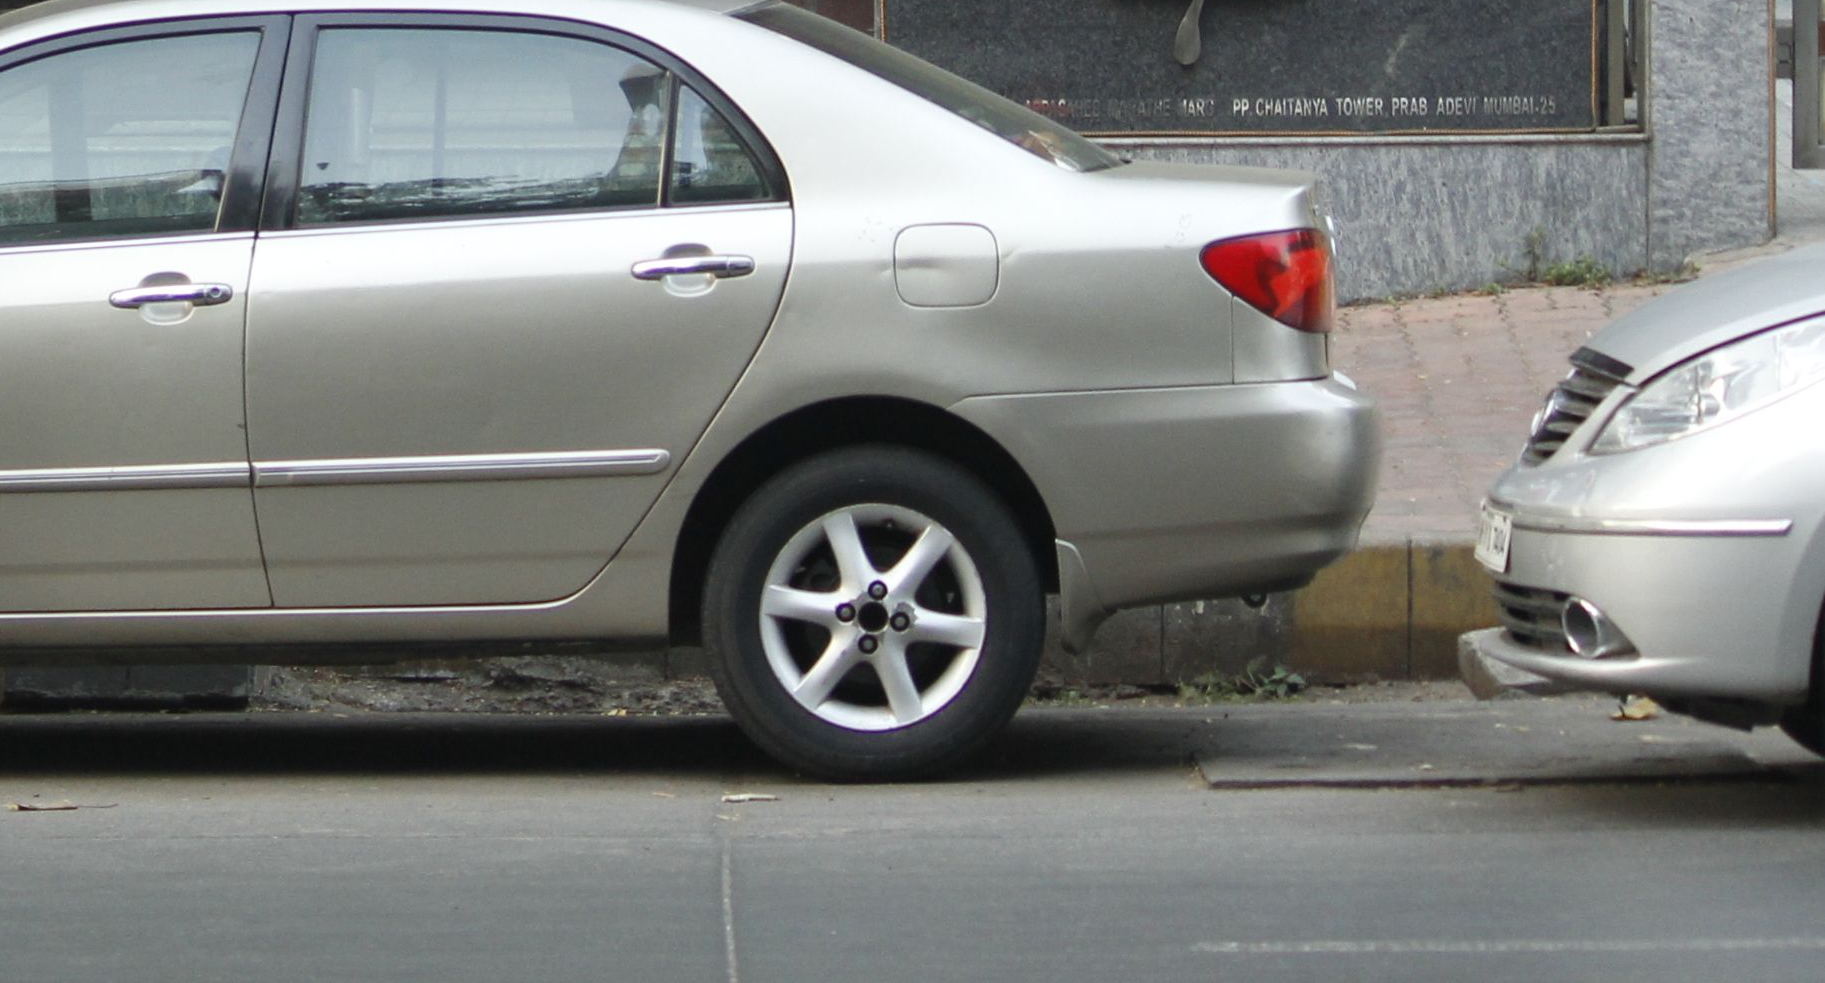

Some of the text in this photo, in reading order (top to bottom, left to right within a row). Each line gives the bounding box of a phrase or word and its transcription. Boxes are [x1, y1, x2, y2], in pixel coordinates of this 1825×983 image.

[1255, 97, 1329, 116] CHAITANYA
[1391, 97, 1428, 116] PRAB
[1436, 96, 1476, 116] ADEVI
